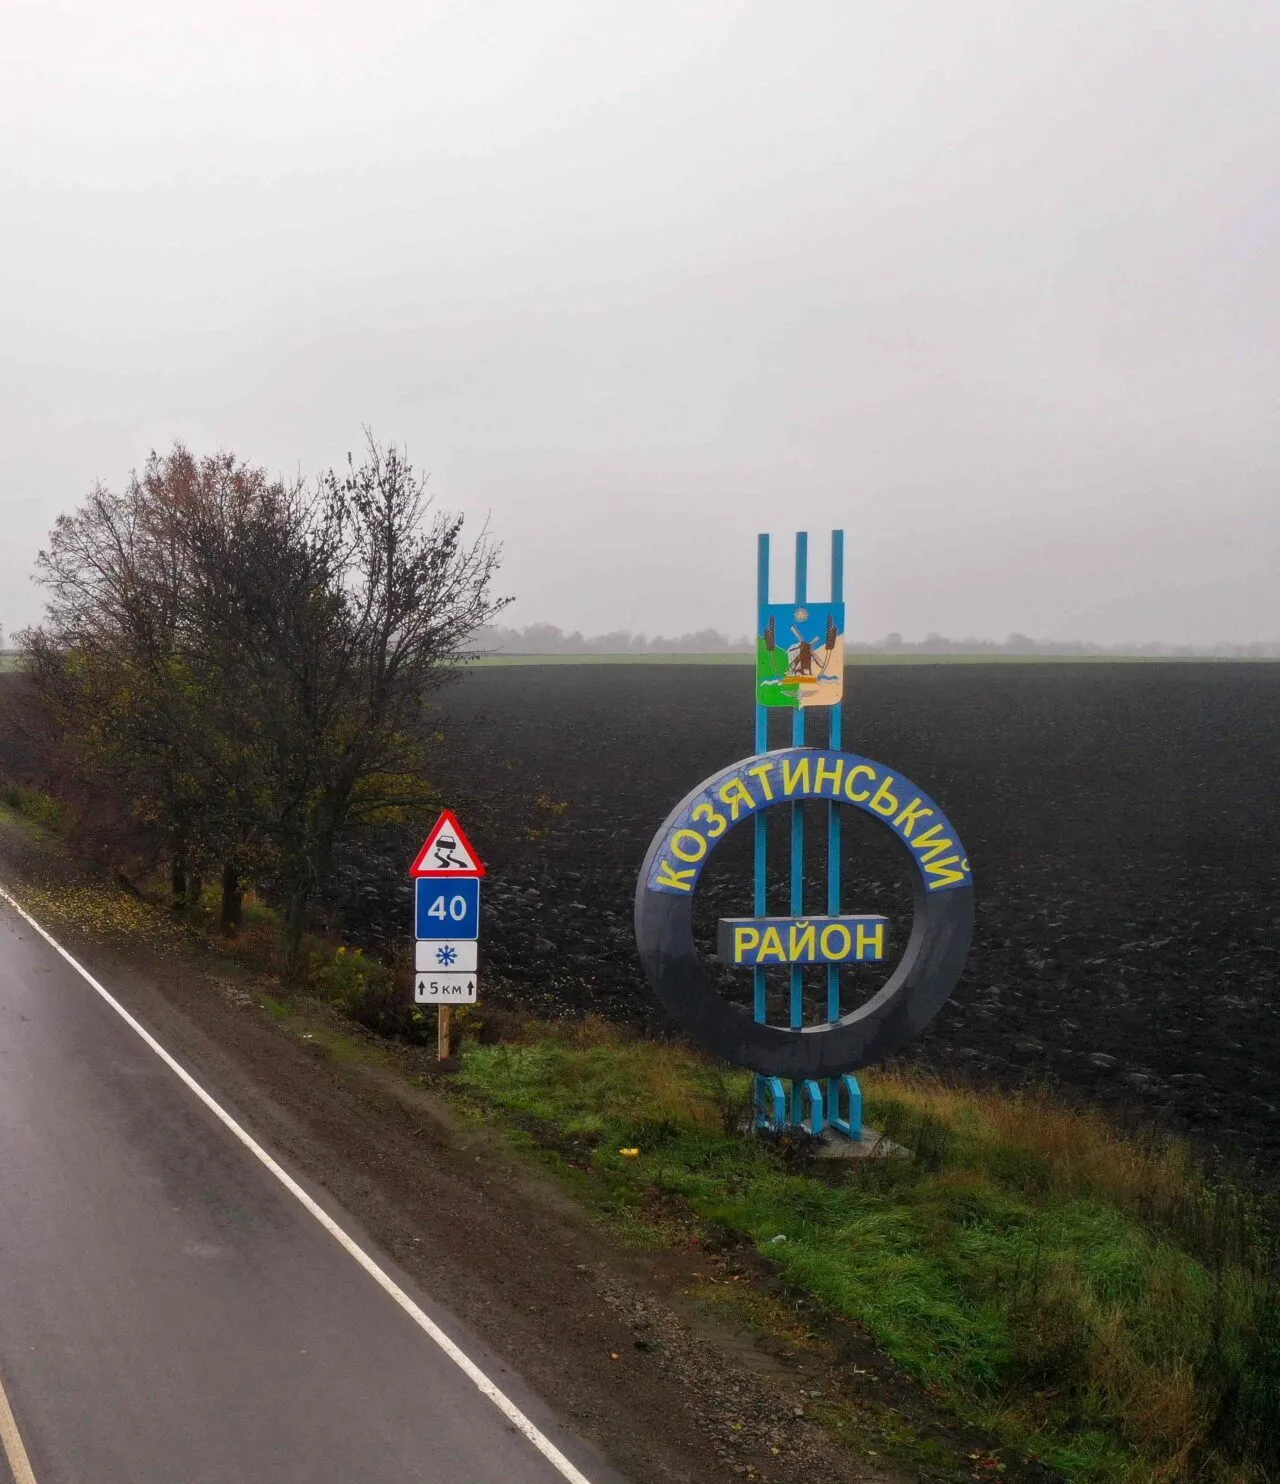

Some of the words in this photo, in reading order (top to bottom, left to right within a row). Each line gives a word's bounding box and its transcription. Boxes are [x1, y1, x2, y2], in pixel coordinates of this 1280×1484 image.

[655, 757, 972, 892] КОЗЯТИНСЬКИЙ
[427, 895, 467, 921] 40
[734, 921, 883, 963] РАЙОН
[430, 982, 438, 995] 5
